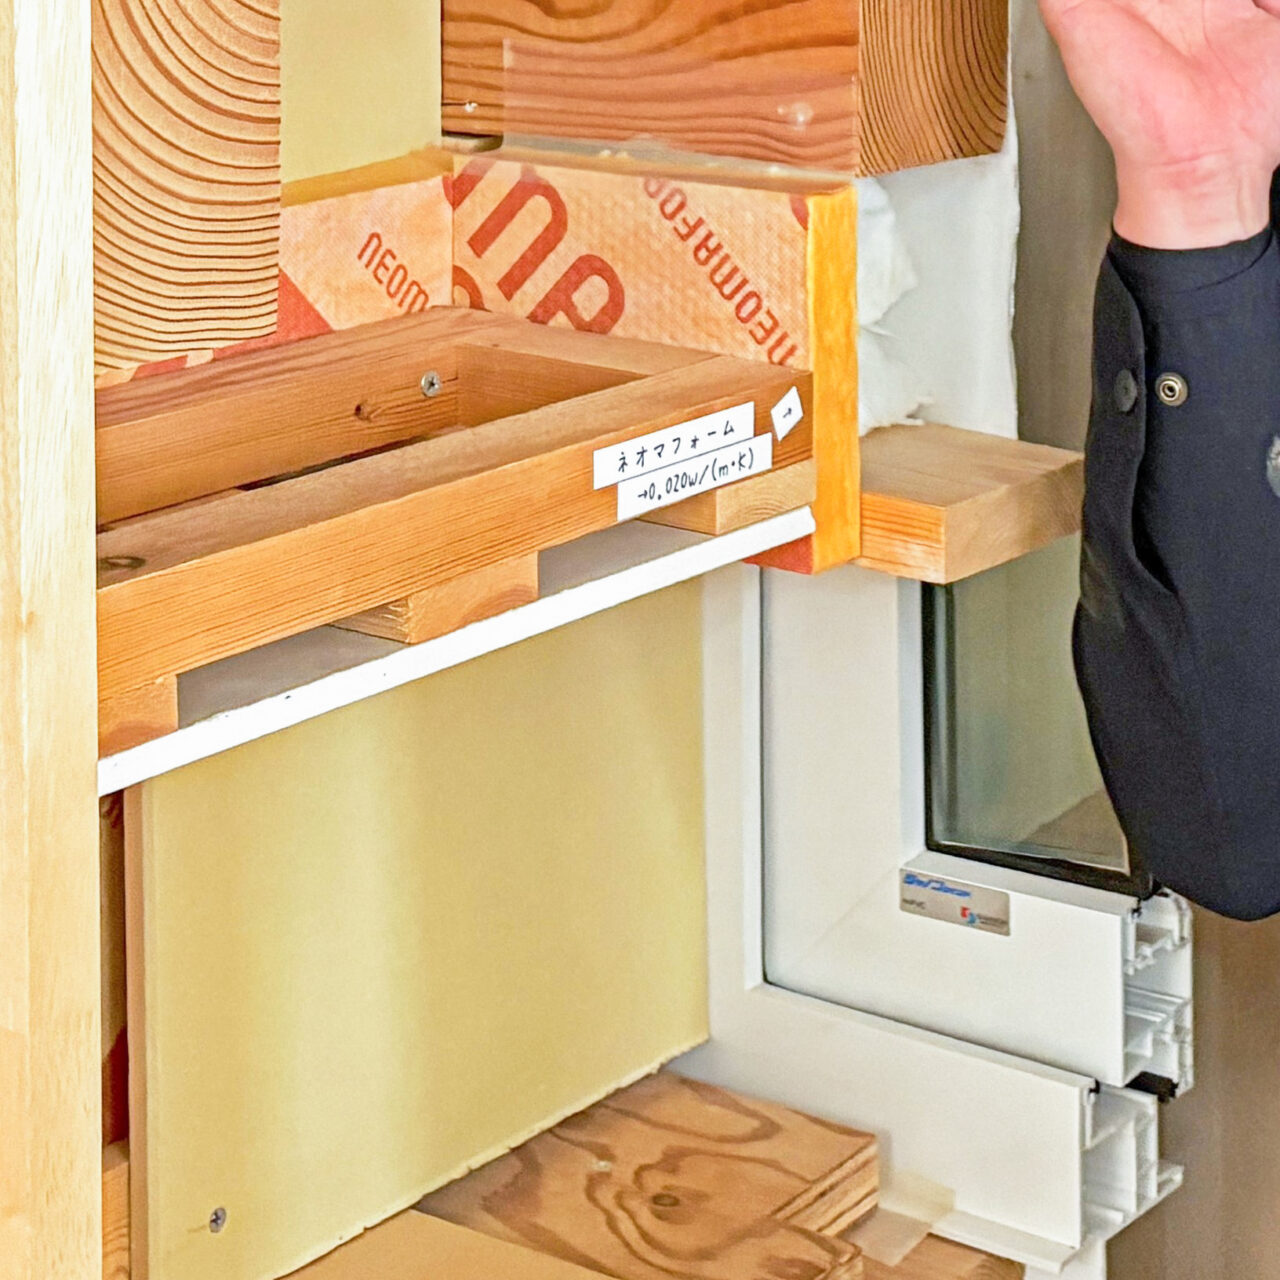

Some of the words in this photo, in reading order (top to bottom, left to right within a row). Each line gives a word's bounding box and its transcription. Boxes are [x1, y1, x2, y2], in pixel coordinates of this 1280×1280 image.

[617, 419, 736, 473] ネオマフォーム
